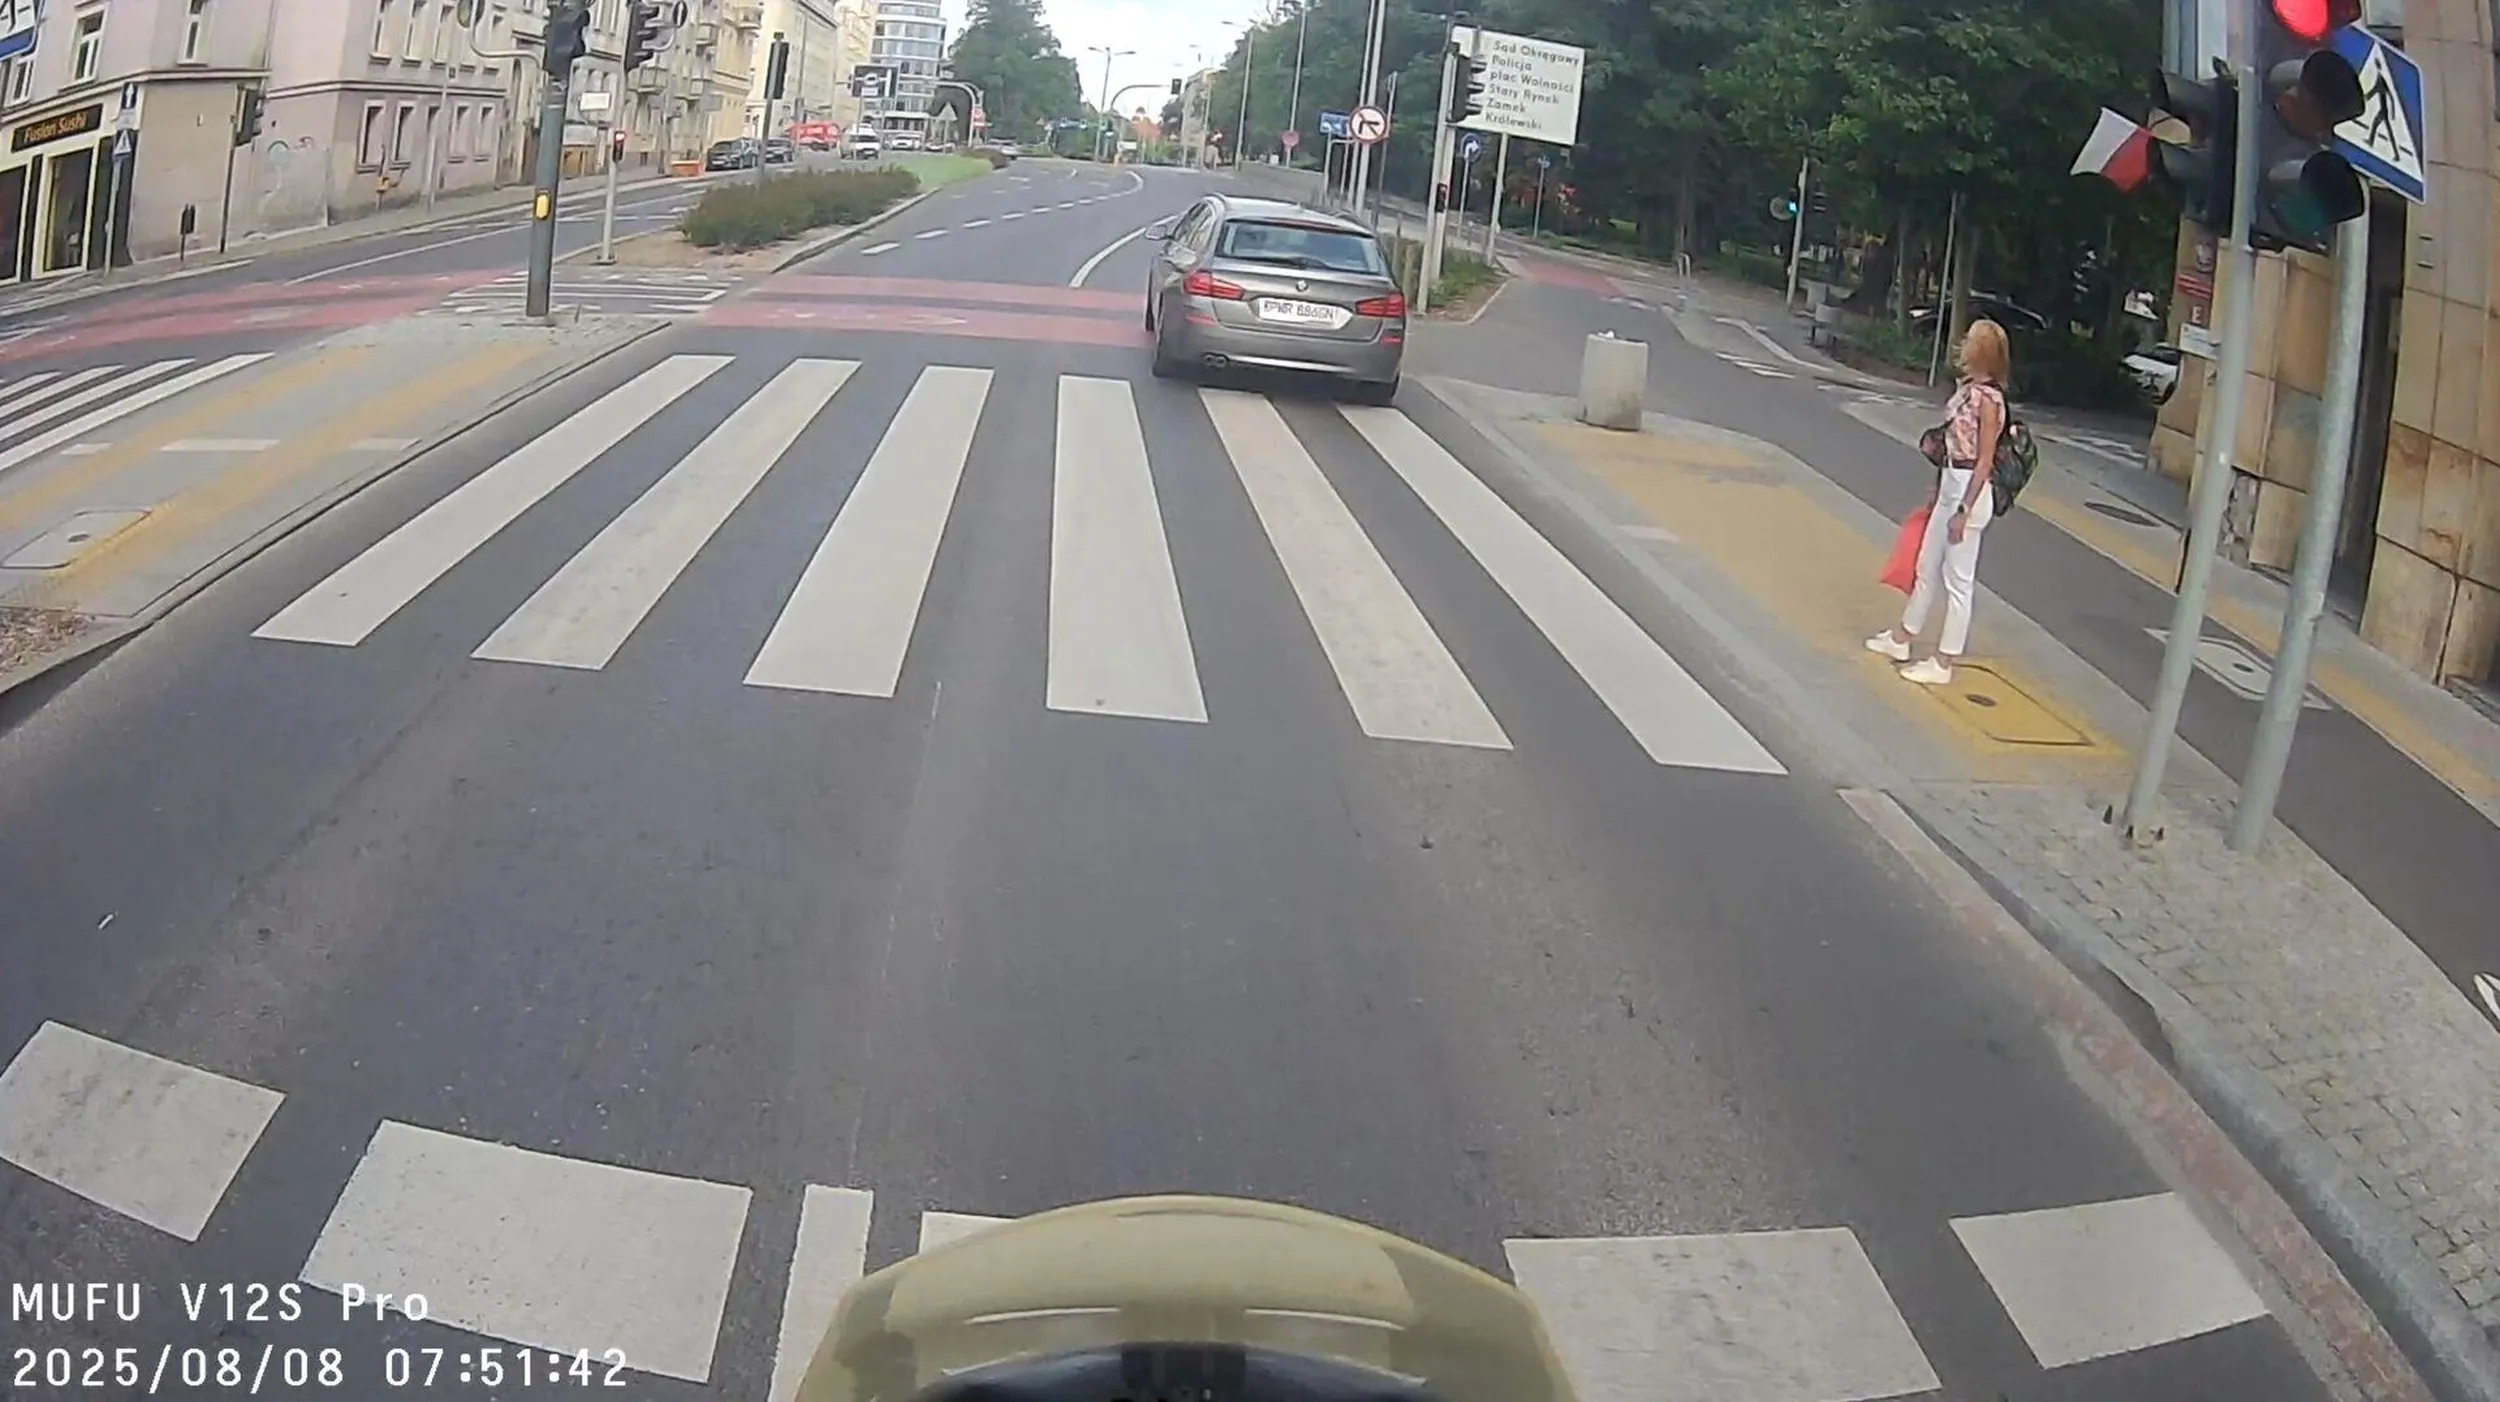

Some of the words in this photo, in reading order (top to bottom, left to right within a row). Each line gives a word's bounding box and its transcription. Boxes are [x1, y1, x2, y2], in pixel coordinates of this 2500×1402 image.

[1492, 55, 1532, 71] Policja
[1490, 70, 1517, 83] plac
[1488, 83, 1519, 99] Stary
[1487, 98, 1526, 113] Zamek
